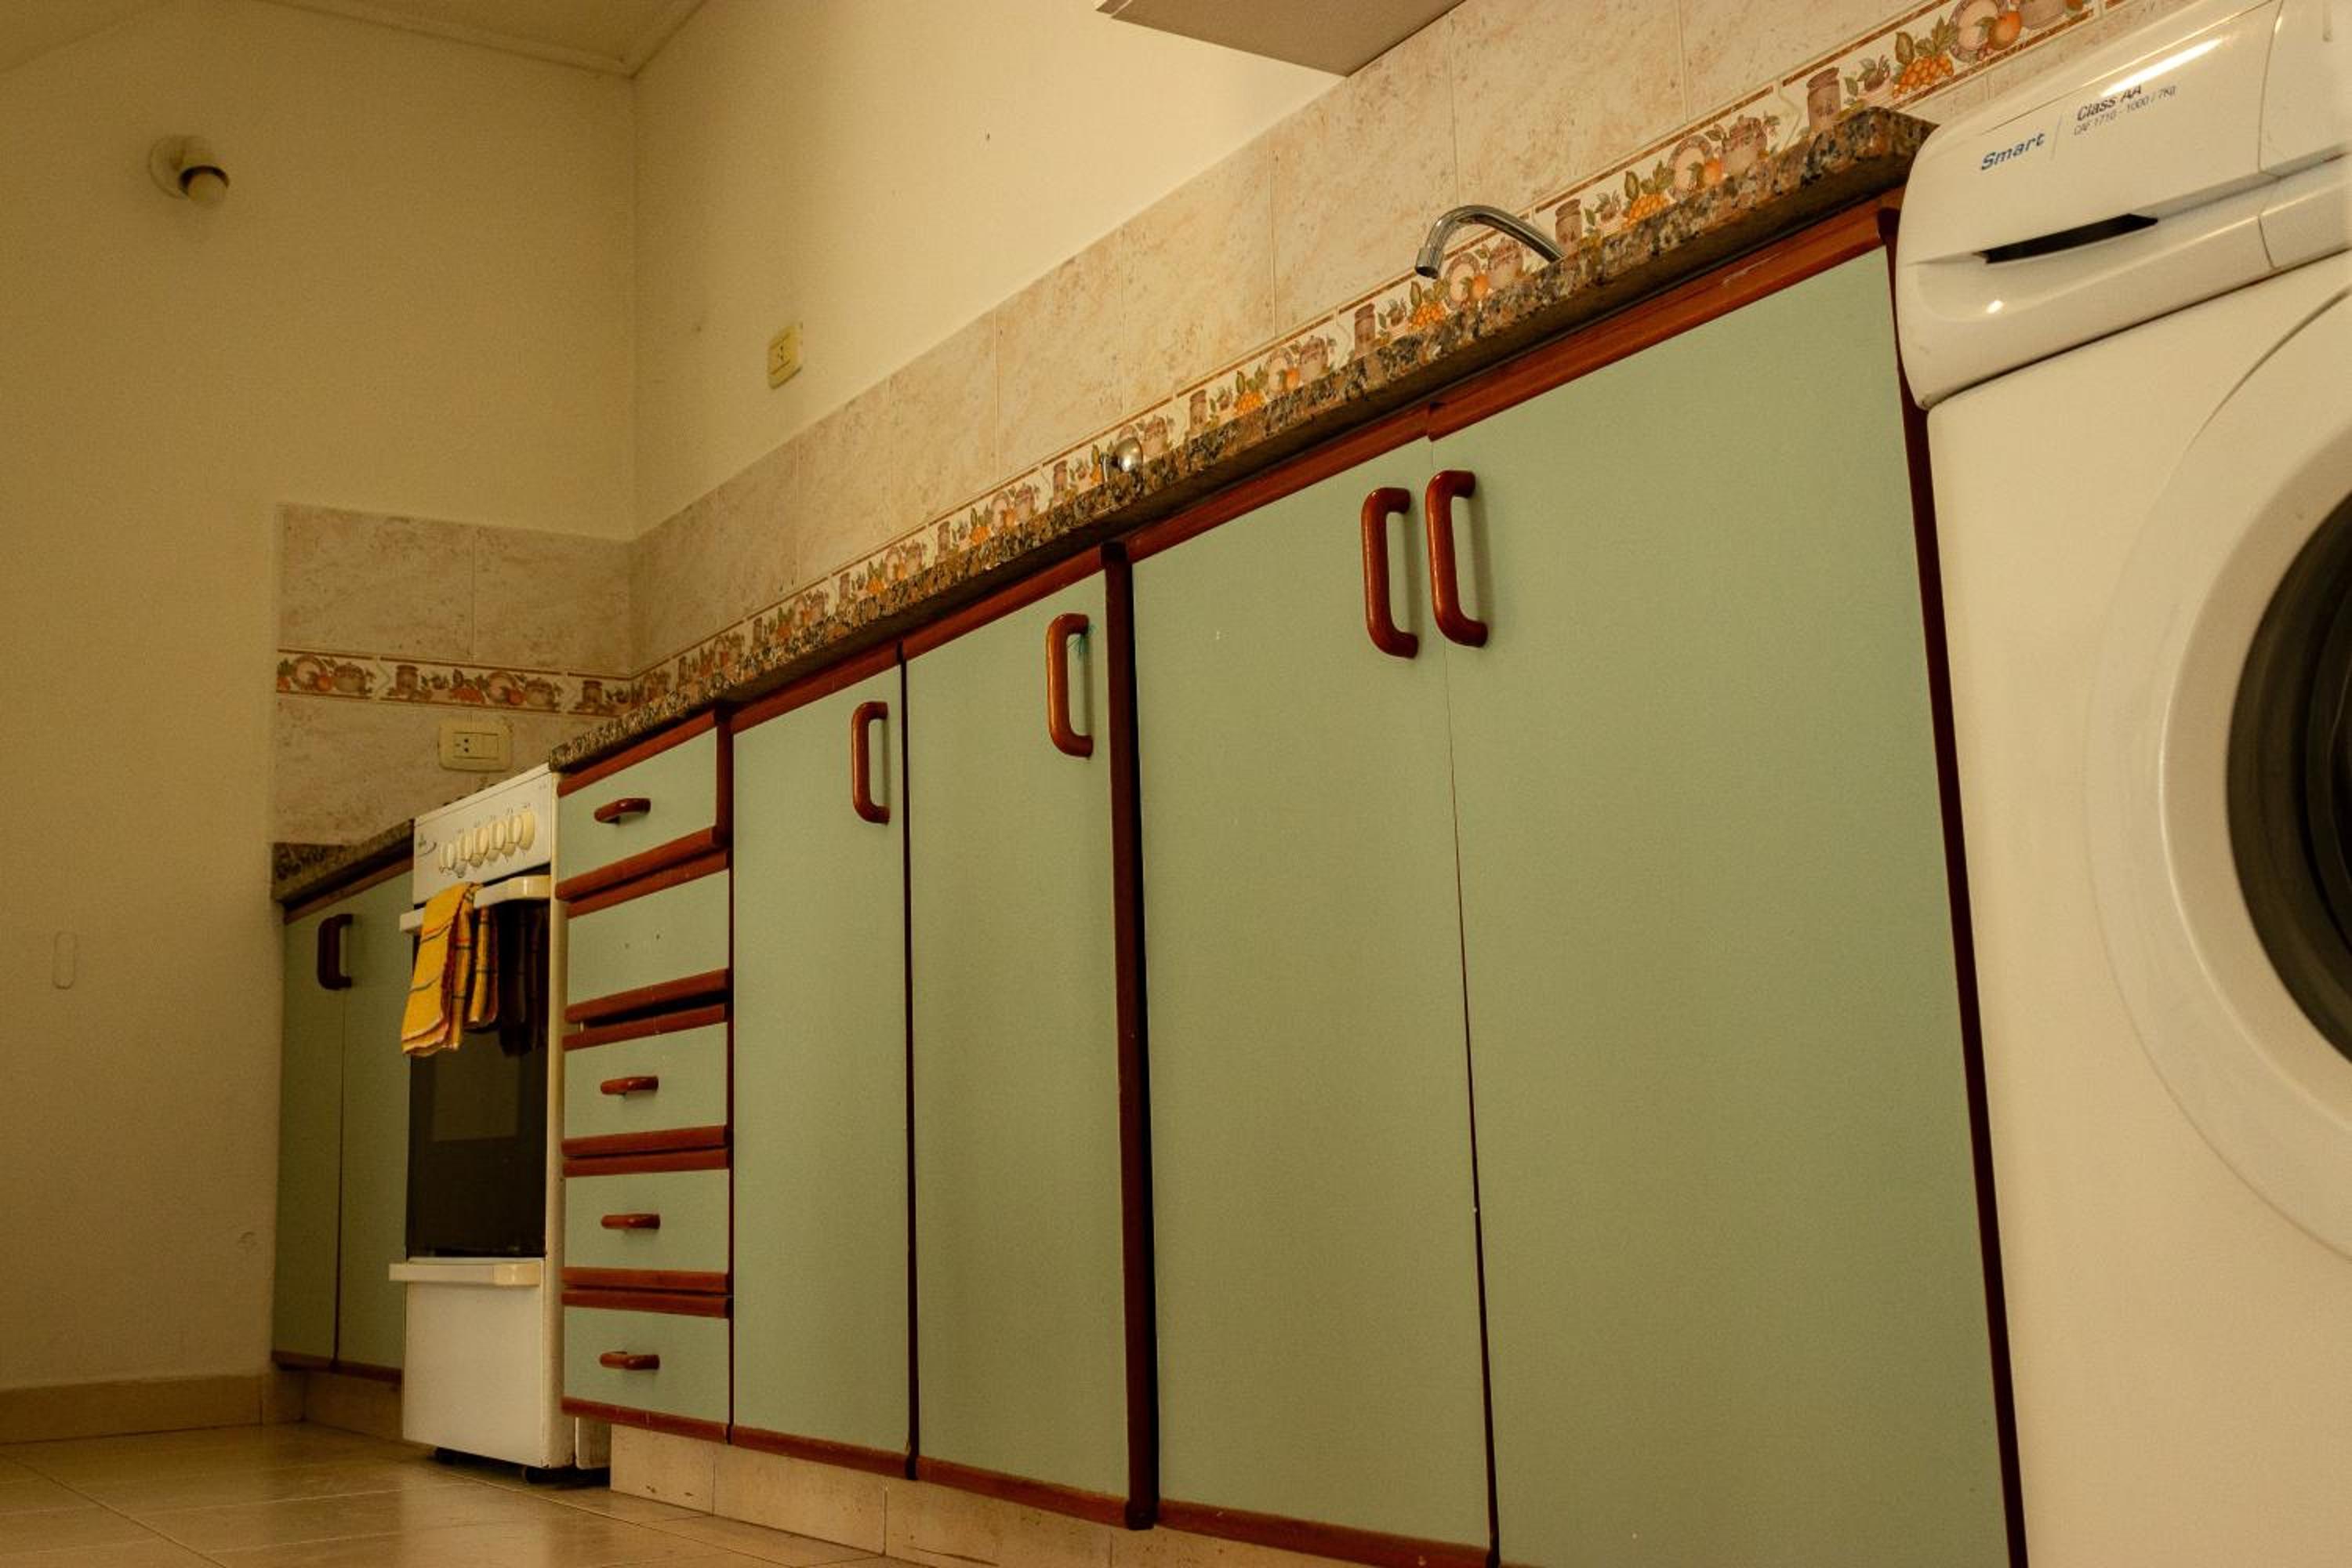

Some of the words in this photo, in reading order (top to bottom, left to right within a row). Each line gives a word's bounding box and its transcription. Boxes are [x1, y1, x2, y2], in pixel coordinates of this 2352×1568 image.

[2078, 98, 2116, 121] Class
[2120, 85, 2141, 102] AA
[2127, 96, 2149, 112] 1000
[1982, 133, 2045, 170] Smart
